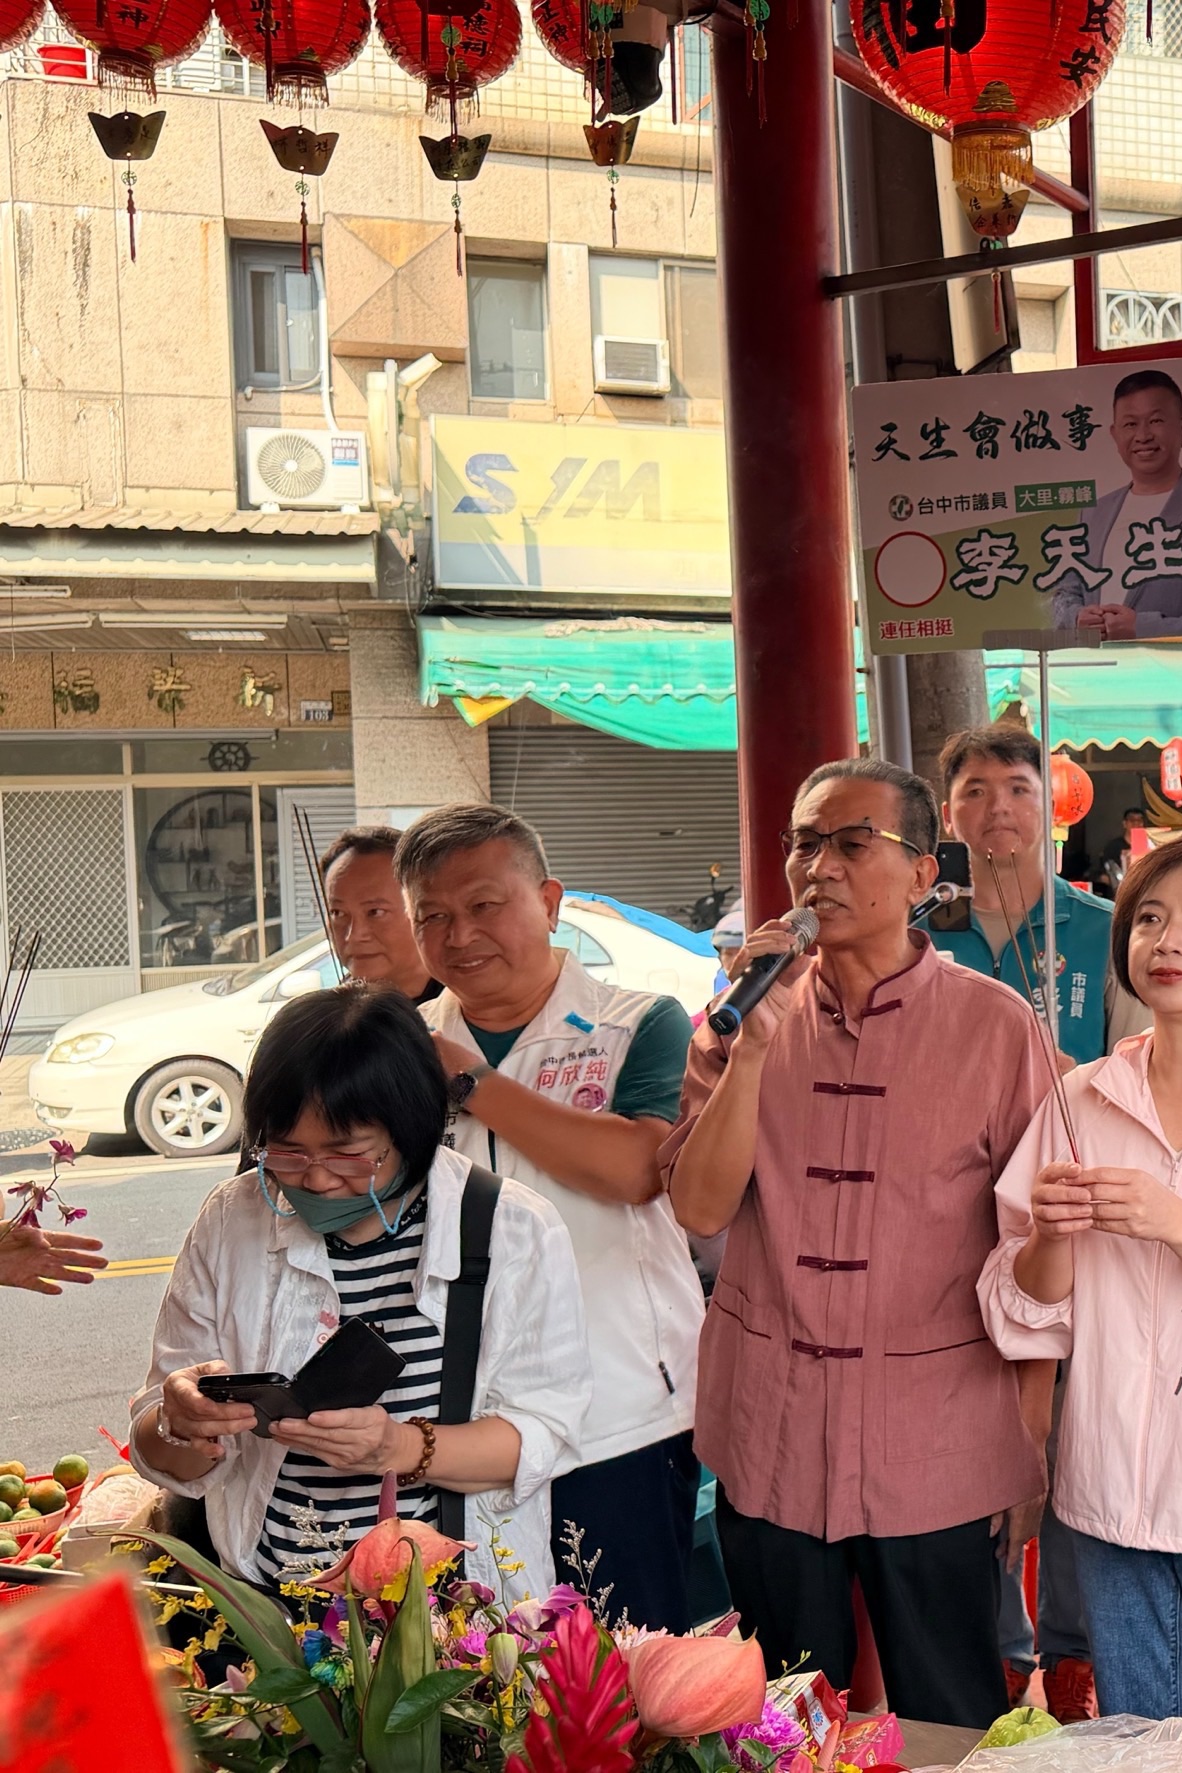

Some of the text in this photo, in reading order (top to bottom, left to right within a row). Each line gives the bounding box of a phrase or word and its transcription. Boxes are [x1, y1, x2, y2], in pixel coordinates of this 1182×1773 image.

[872, 404, 1102, 462] 天生會做事
[917, 491, 1008, 515] 台中市議員
[880, 618, 953, 641] 連任相挺
[1070, 972, 1087, 1018] 市議員
[537, 1059, 608, 1091] 何欣純
